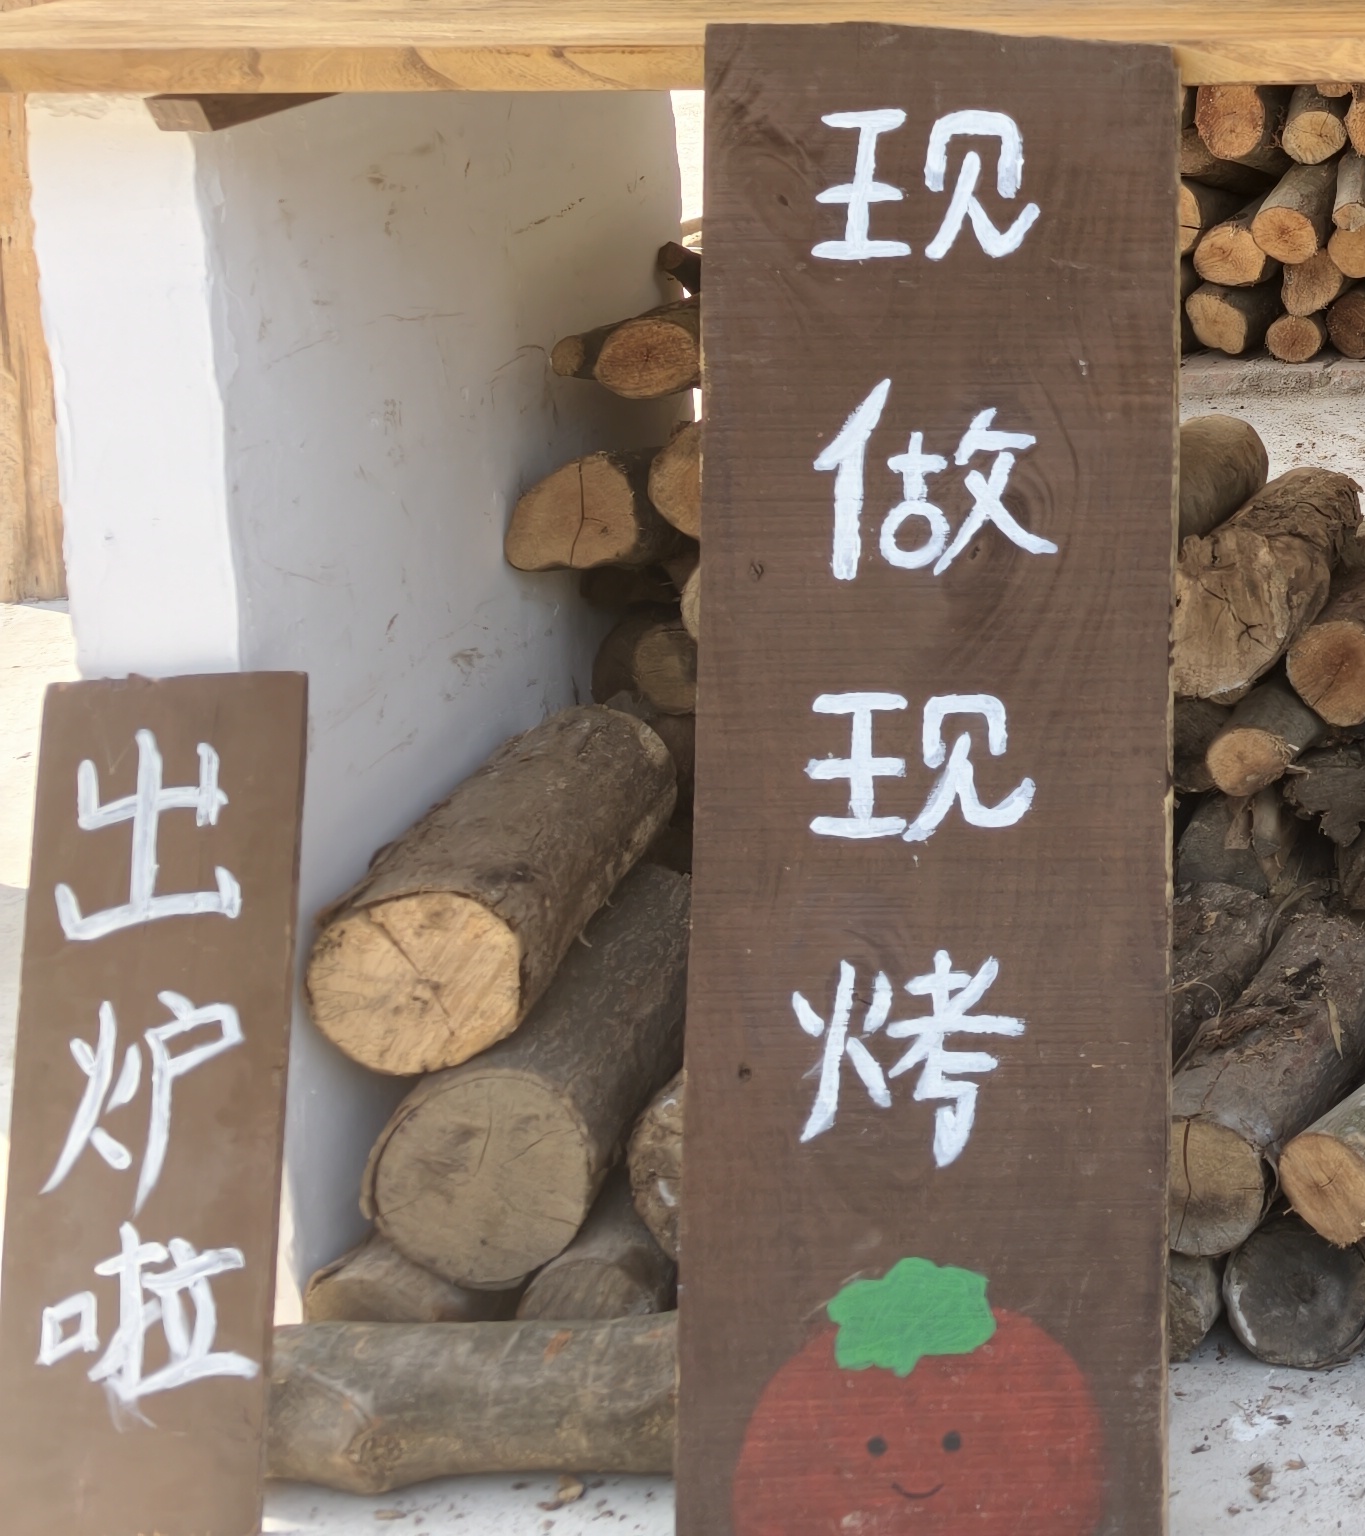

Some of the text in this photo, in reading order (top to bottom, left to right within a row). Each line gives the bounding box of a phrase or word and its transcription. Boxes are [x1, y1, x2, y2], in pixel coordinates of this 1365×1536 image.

[37, 729, 259, 1405] 出炉啦
[792, 109, 1058, 1168] 现做现烤
